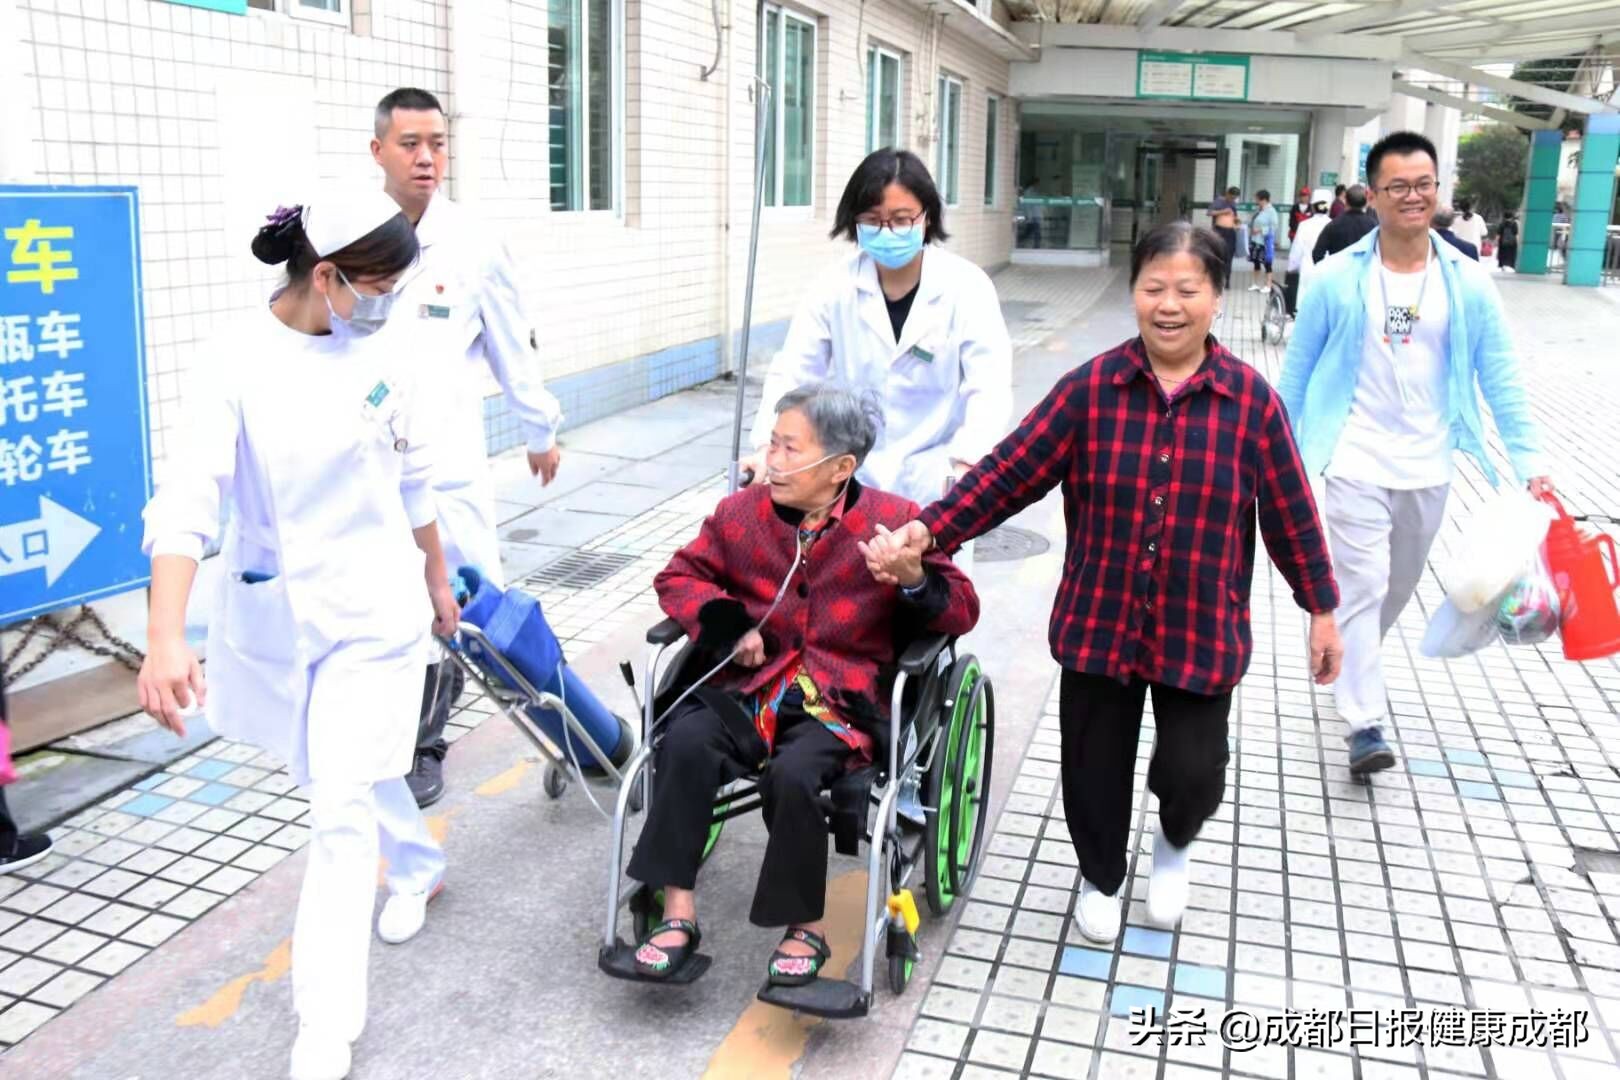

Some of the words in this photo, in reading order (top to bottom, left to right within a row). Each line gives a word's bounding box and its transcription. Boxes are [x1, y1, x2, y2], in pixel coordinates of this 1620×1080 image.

[4, 218, 79, 294] 车
[0, 309, 84, 364] 瓶车
[0, 370, 88, 426] 托车
[0, 428, 92, 486] 轮车
